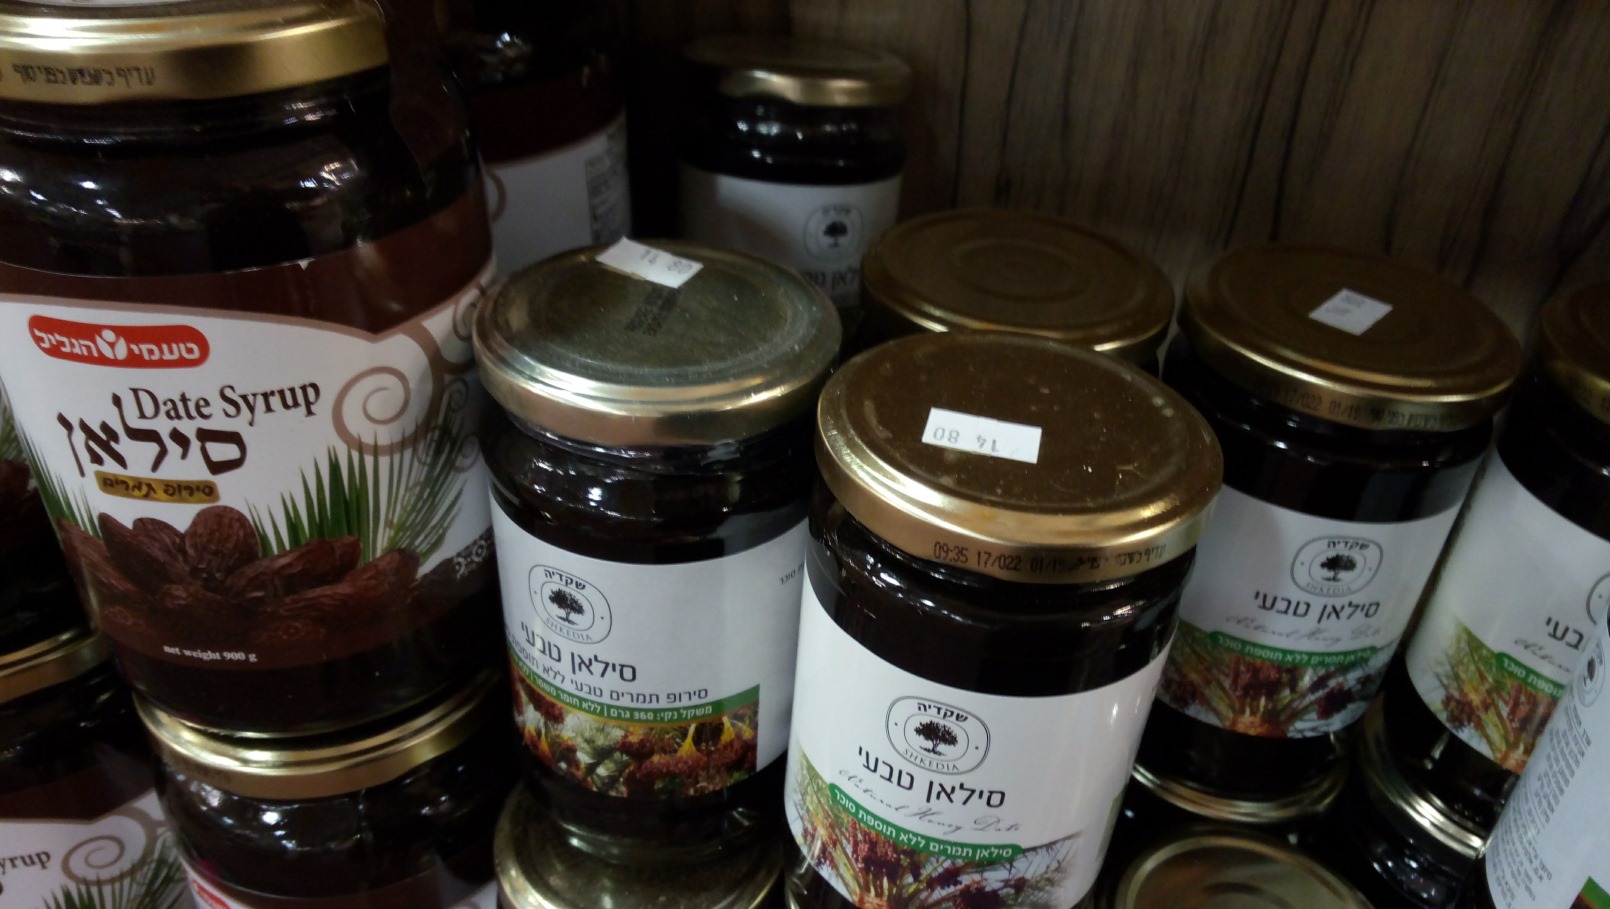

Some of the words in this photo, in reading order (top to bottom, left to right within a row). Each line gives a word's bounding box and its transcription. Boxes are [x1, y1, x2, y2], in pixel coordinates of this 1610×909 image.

[832, 266, 860, 292] לאן
[33, 327, 98, 358] הגליל
[131, 341, 200, 361] טעמי
[129, 387, 213, 421] Date
[219, 381, 321, 426] Syrup
[57, 392, 248, 478] סילאן
[932, 426, 960, 444] 80
[975, 434, 1000, 453] 14
[101, 476, 157, 497] תמרים
[163, 484, 215, 498] סירופ
[933, 540, 969, 565] 09:35
[976, 549, 1022, 572] 17/022
[1326, 539, 1370, 552] שקדיה
[543, 569, 587, 591] שקדיה
[1254, 590, 1311, 618] טבעי
[1318, 600, 1381, 624] סילאן
[545, 616, 594, 642] SHKEDIA
[1545, 616, 1584, 651] בעי
[521, 621, 562, 664] טבעי
[163, 644, 182, 656] net
[183, 647, 222, 662] weight
[223, 650, 247, 662] 900
[248, 653, 258, 663] g
[541, 664, 566, 685] ללא
[571, 651, 638, 683] סילאן
[557, 690, 581, 707] חומר
[569, 679, 603, 699] טבעי
[609, 688, 660, 705] תמרים
[666, 688, 709, 704] סירופ
[580, 701, 603, 715] ללא
[609, 708, 631, 721] גרם
[633, 711, 653, 721] 360
[656, 711, 679, 722] נקי:
[680, 705, 713, 719] משקל
[917, 701, 969, 723] שקדיה
[858, 745, 915, 791] טבעי
[901, 748, 961, 772] SHKEDIA
[834, 788, 857, 814] סוכר
[838, 768, 910, 812] Natural
[904, 805, 963, 836] Honey
[972, 814, 1022, 833] Date
[926, 780, 1006, 809] סילאן
[859, 810, 897, 837] תוספת
[899, 832, 926, 850] ללא
[929, 842, 973, 858] תמרים
[0, 850, 52, 876] yrup
[975, 847, 1013, 861] סילאן
